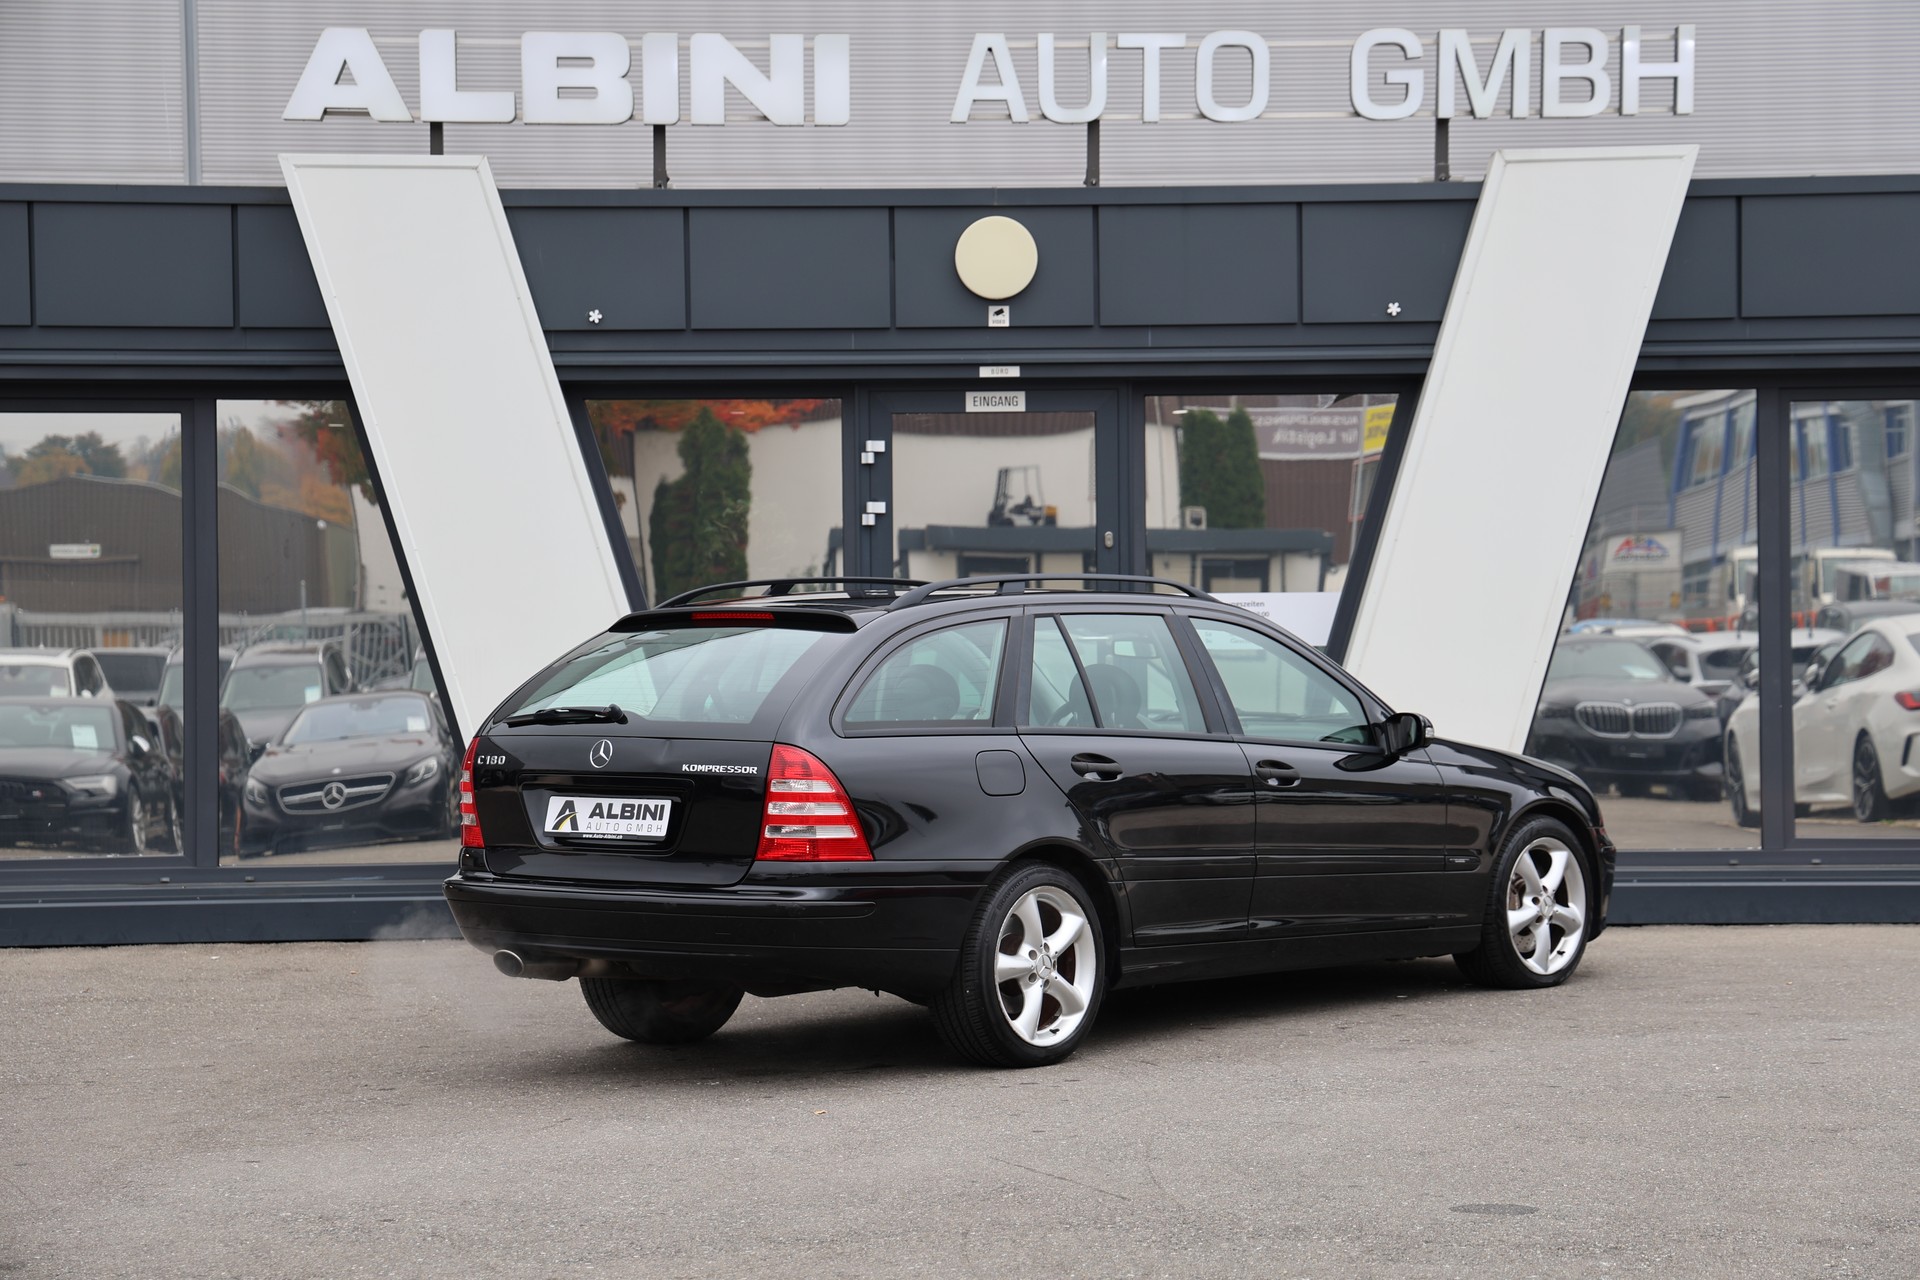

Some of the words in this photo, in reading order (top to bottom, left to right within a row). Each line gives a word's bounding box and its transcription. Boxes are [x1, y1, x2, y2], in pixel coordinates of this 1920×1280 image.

[282, 27, 850, 126] ALBINI
[950, 30, 1270, 125] AUTO
[1349, 24, 1696, 122] GMBH
[990, 367, 1009, 375] BÜRO
[972, 395, 1019, 407] EINGANG
[681, 763, 758, 775] KOMPRESSOR
[588, 802, 666, 821] ALBINI
[586, 821, 620, 832] AUTO
[626, 823, 663, 833] GMBH
